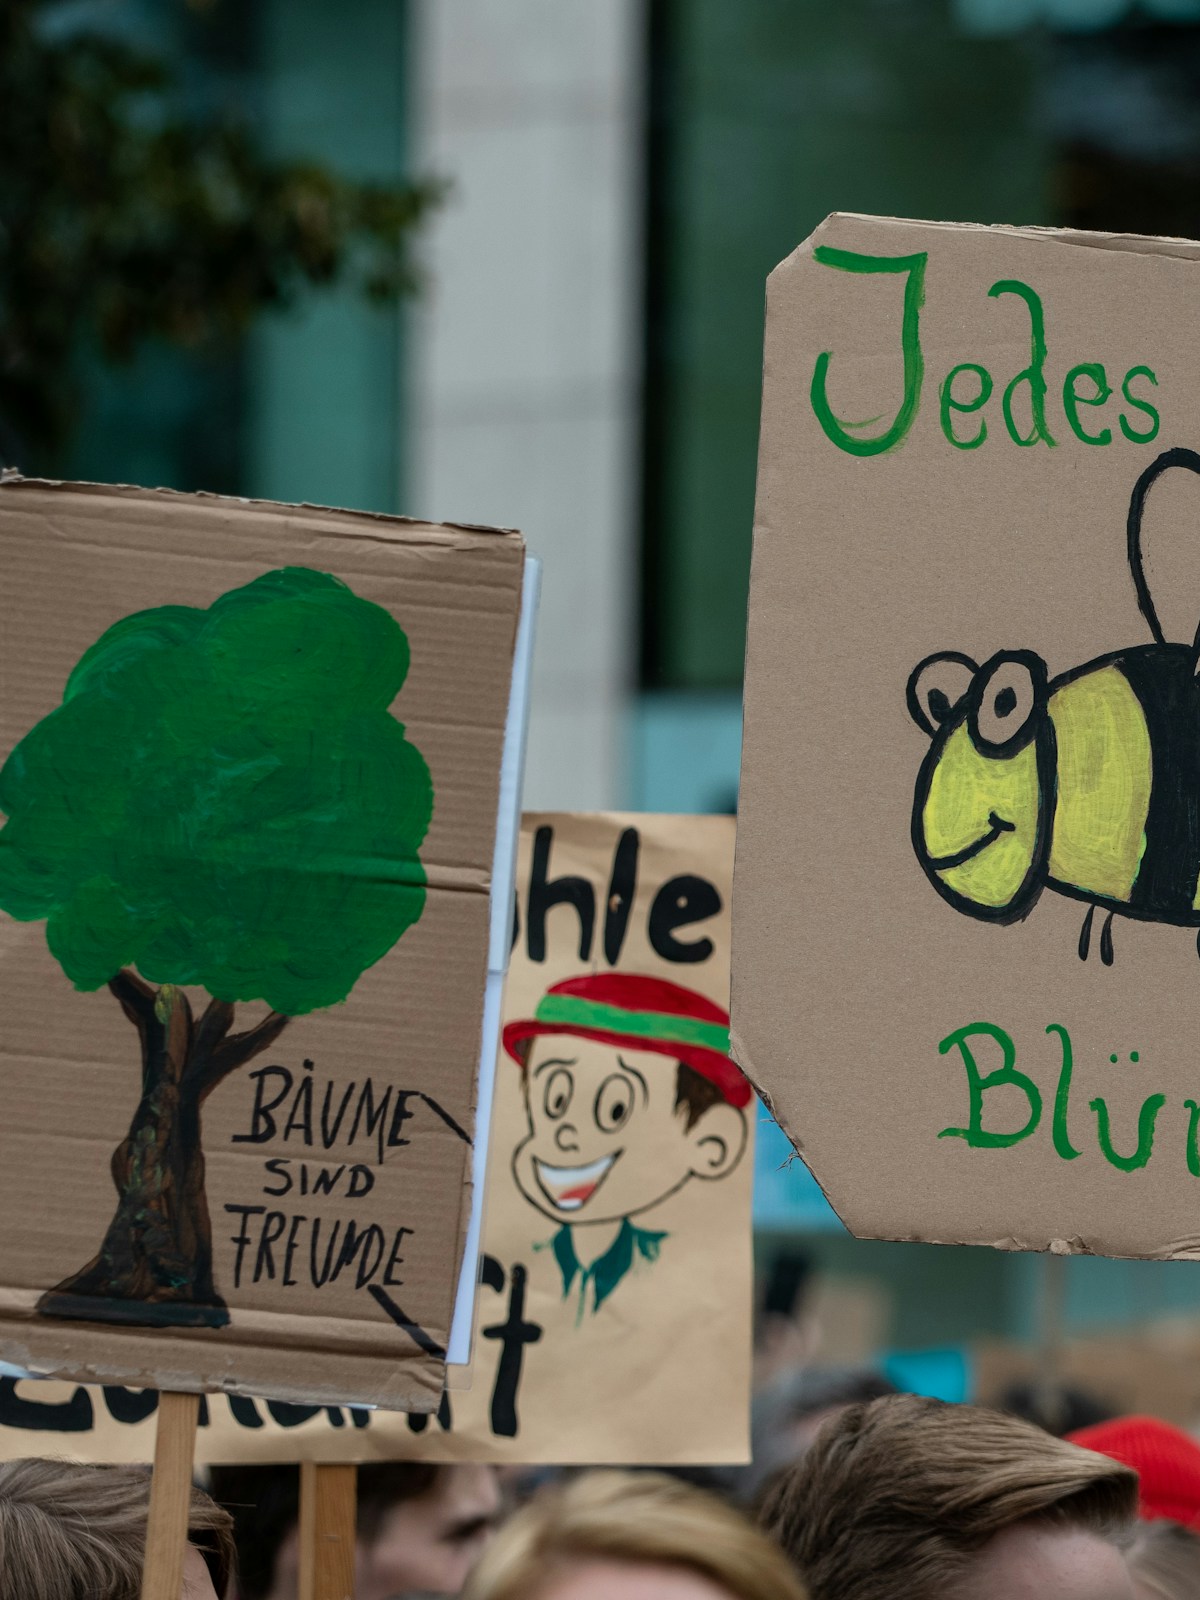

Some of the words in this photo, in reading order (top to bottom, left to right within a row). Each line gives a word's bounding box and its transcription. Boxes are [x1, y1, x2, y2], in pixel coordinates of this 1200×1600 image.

[810, 245, 1161, 457] Jedes
[509, 825, 723, 967] hle
[263, 1158, 375, 1198] SIND
[223, 1203, 415, 1290] FREUNDE
